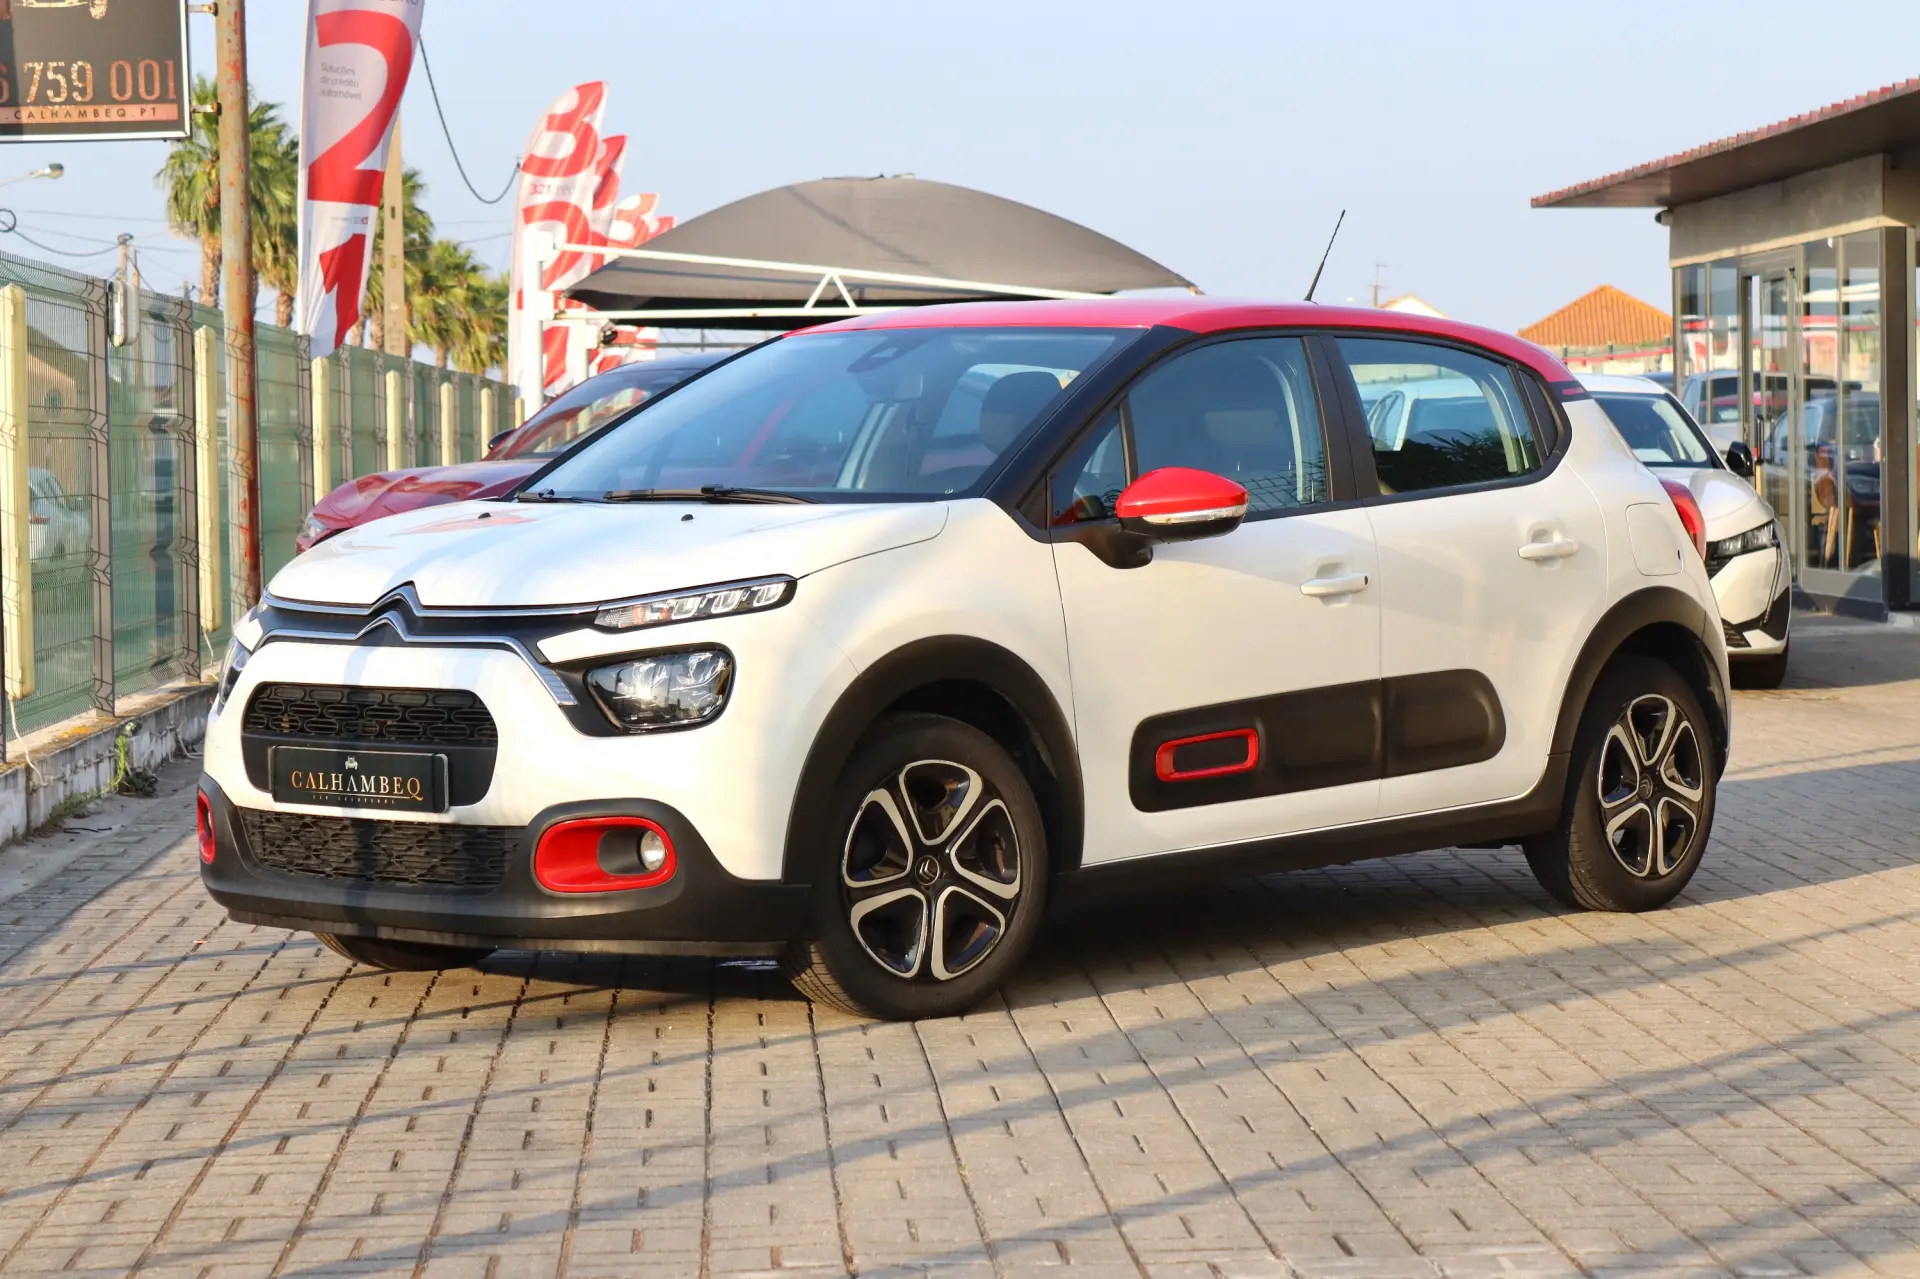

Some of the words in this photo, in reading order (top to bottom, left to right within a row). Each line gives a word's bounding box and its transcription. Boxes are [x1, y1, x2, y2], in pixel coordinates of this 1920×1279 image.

[22, 60, 94, 103] 759
[109, 59, 177, 101] 001
[291, 770, 423, 801] CALHAMBEQ
